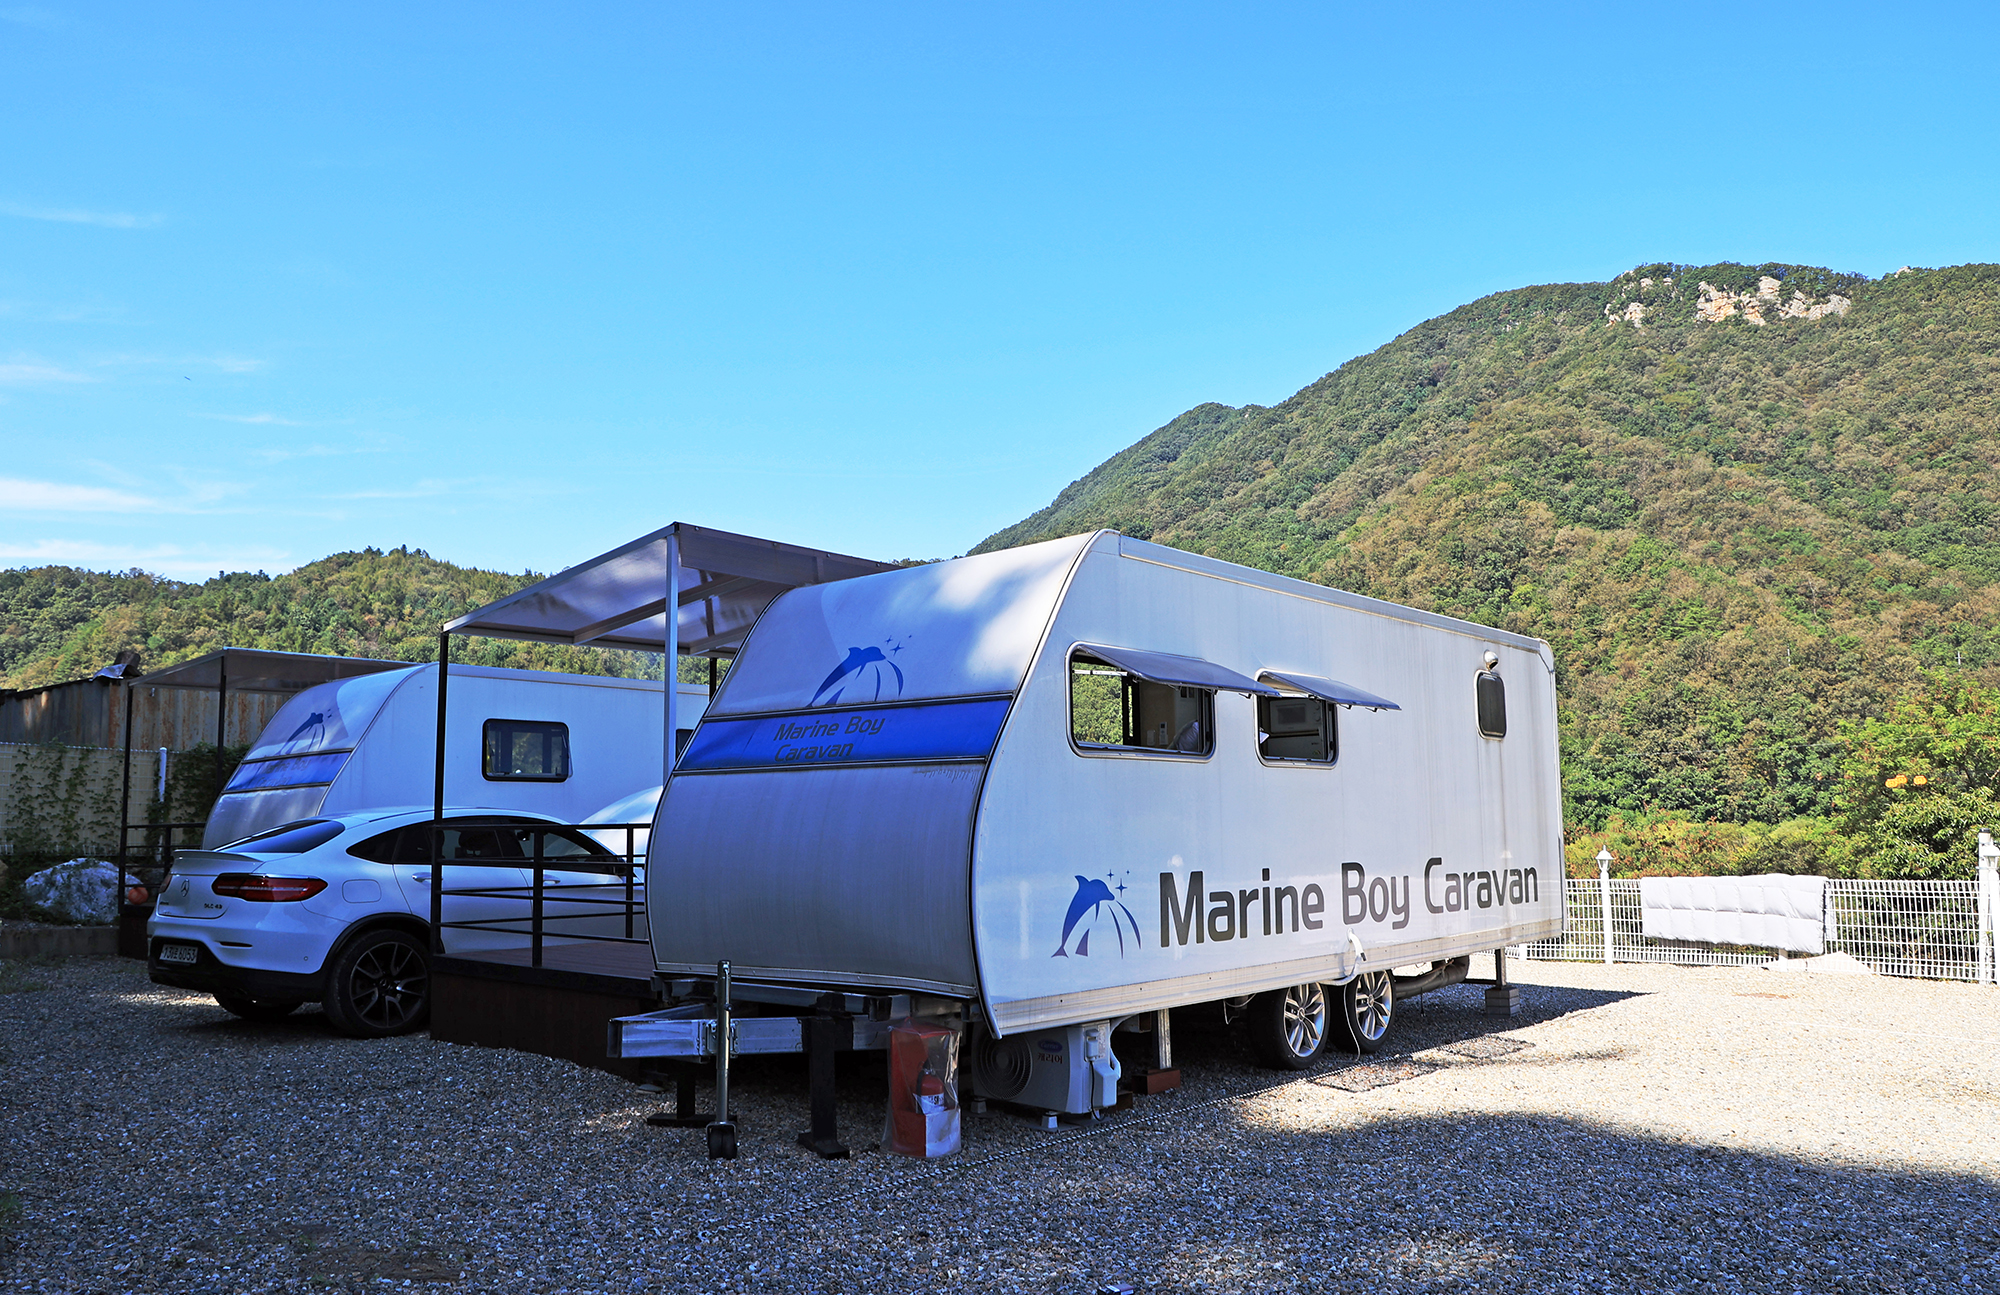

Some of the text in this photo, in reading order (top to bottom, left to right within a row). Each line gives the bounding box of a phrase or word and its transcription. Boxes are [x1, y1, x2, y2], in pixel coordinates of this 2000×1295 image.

[773, 716, 886, 741] Marine Boy
[775, 743, 854, 762] Caravan
[1160, 857, 1539, 948] Marine Boy Caravan
